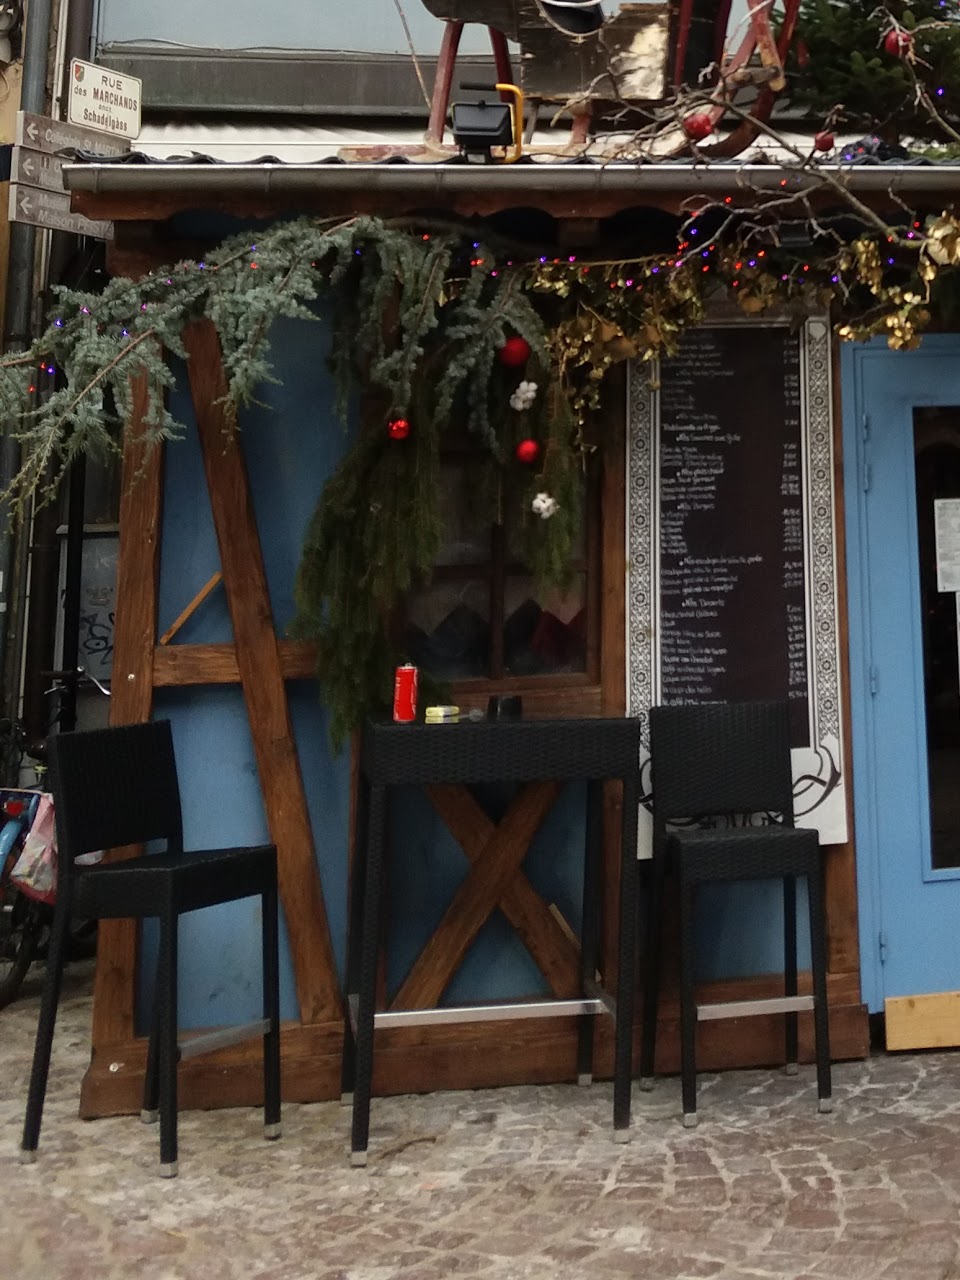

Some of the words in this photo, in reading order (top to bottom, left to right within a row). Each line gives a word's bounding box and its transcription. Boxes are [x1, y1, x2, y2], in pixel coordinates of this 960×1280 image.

[101, 75, 123, 91] RUE
[73, 84, 87, 97] des
[92, 87, 138, 112] MARCHANDS
[37, 209, 74, 228] Maison
